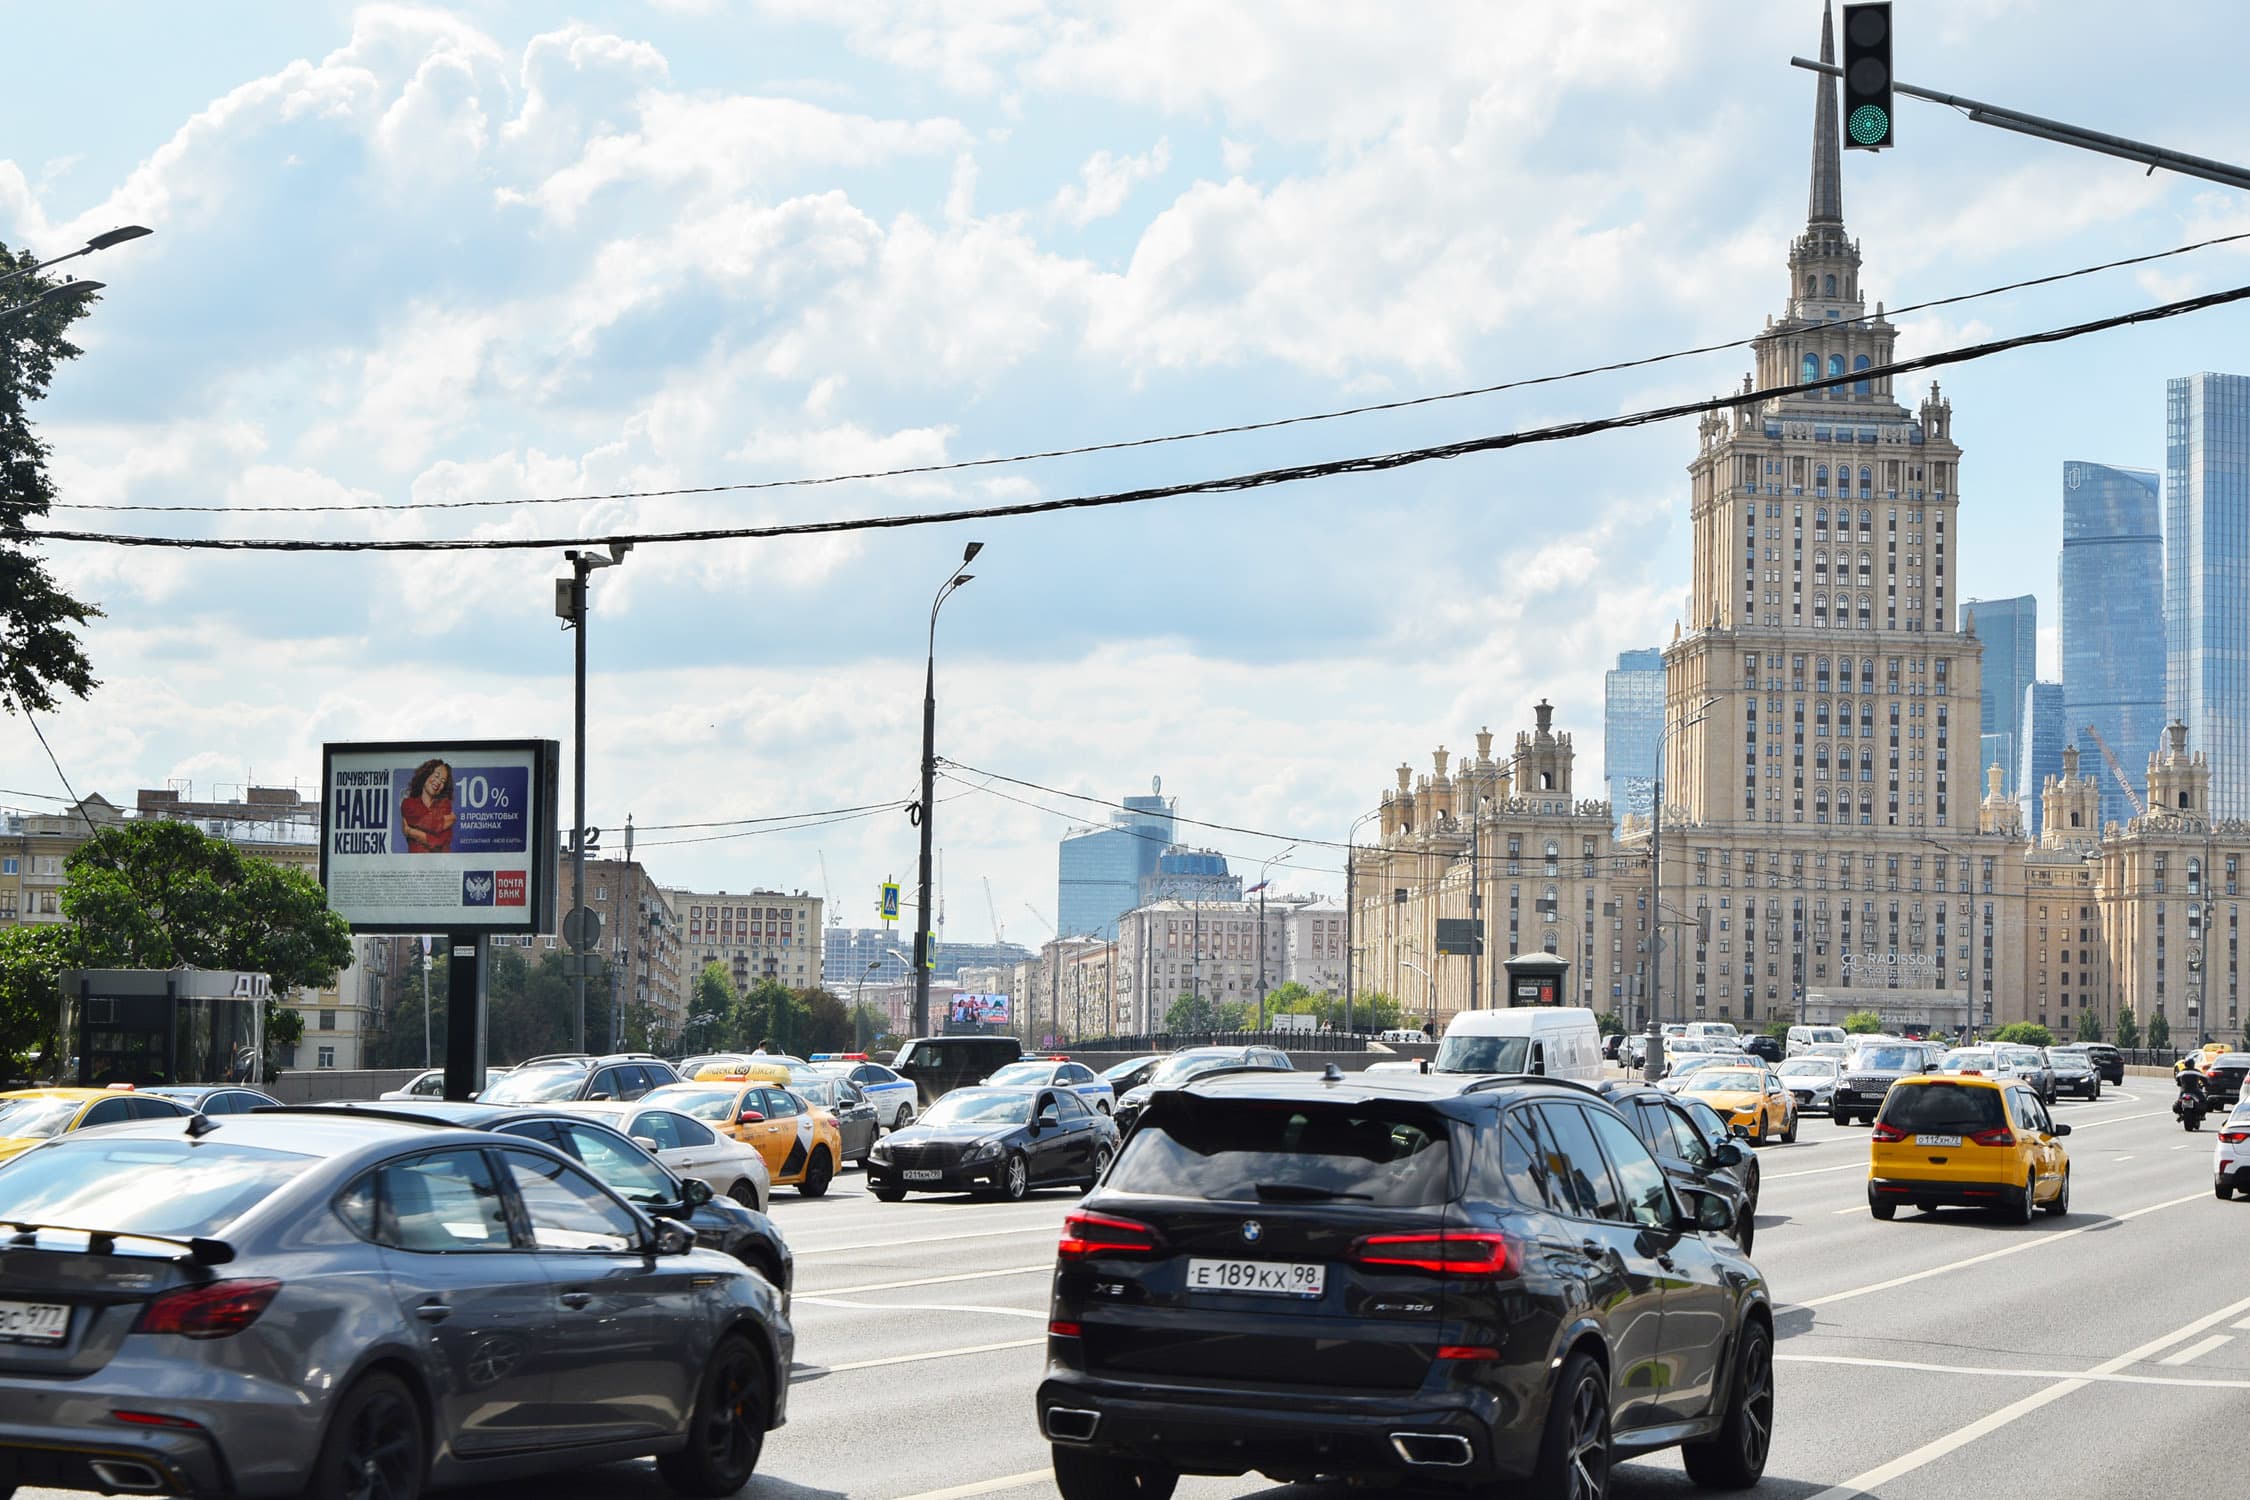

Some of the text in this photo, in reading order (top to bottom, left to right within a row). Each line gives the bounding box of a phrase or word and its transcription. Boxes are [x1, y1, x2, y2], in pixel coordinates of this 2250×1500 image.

[336, 769, 389, 786] ПОЧУВСТВУЙ
[335, 788, 388, 829] НАШ
[466, 812, 519, 821] ПРОДУКТОВЫХ
[460, 822, 502, 830] МАГАЗИНАХ
[334, 831, 387, 855] КЕШБЭК
[498, 878, 524, 888] ПОЧТА
[498, 889, 520, 899] БАНК
[1867, 952, 1937, 966] RADISSON
